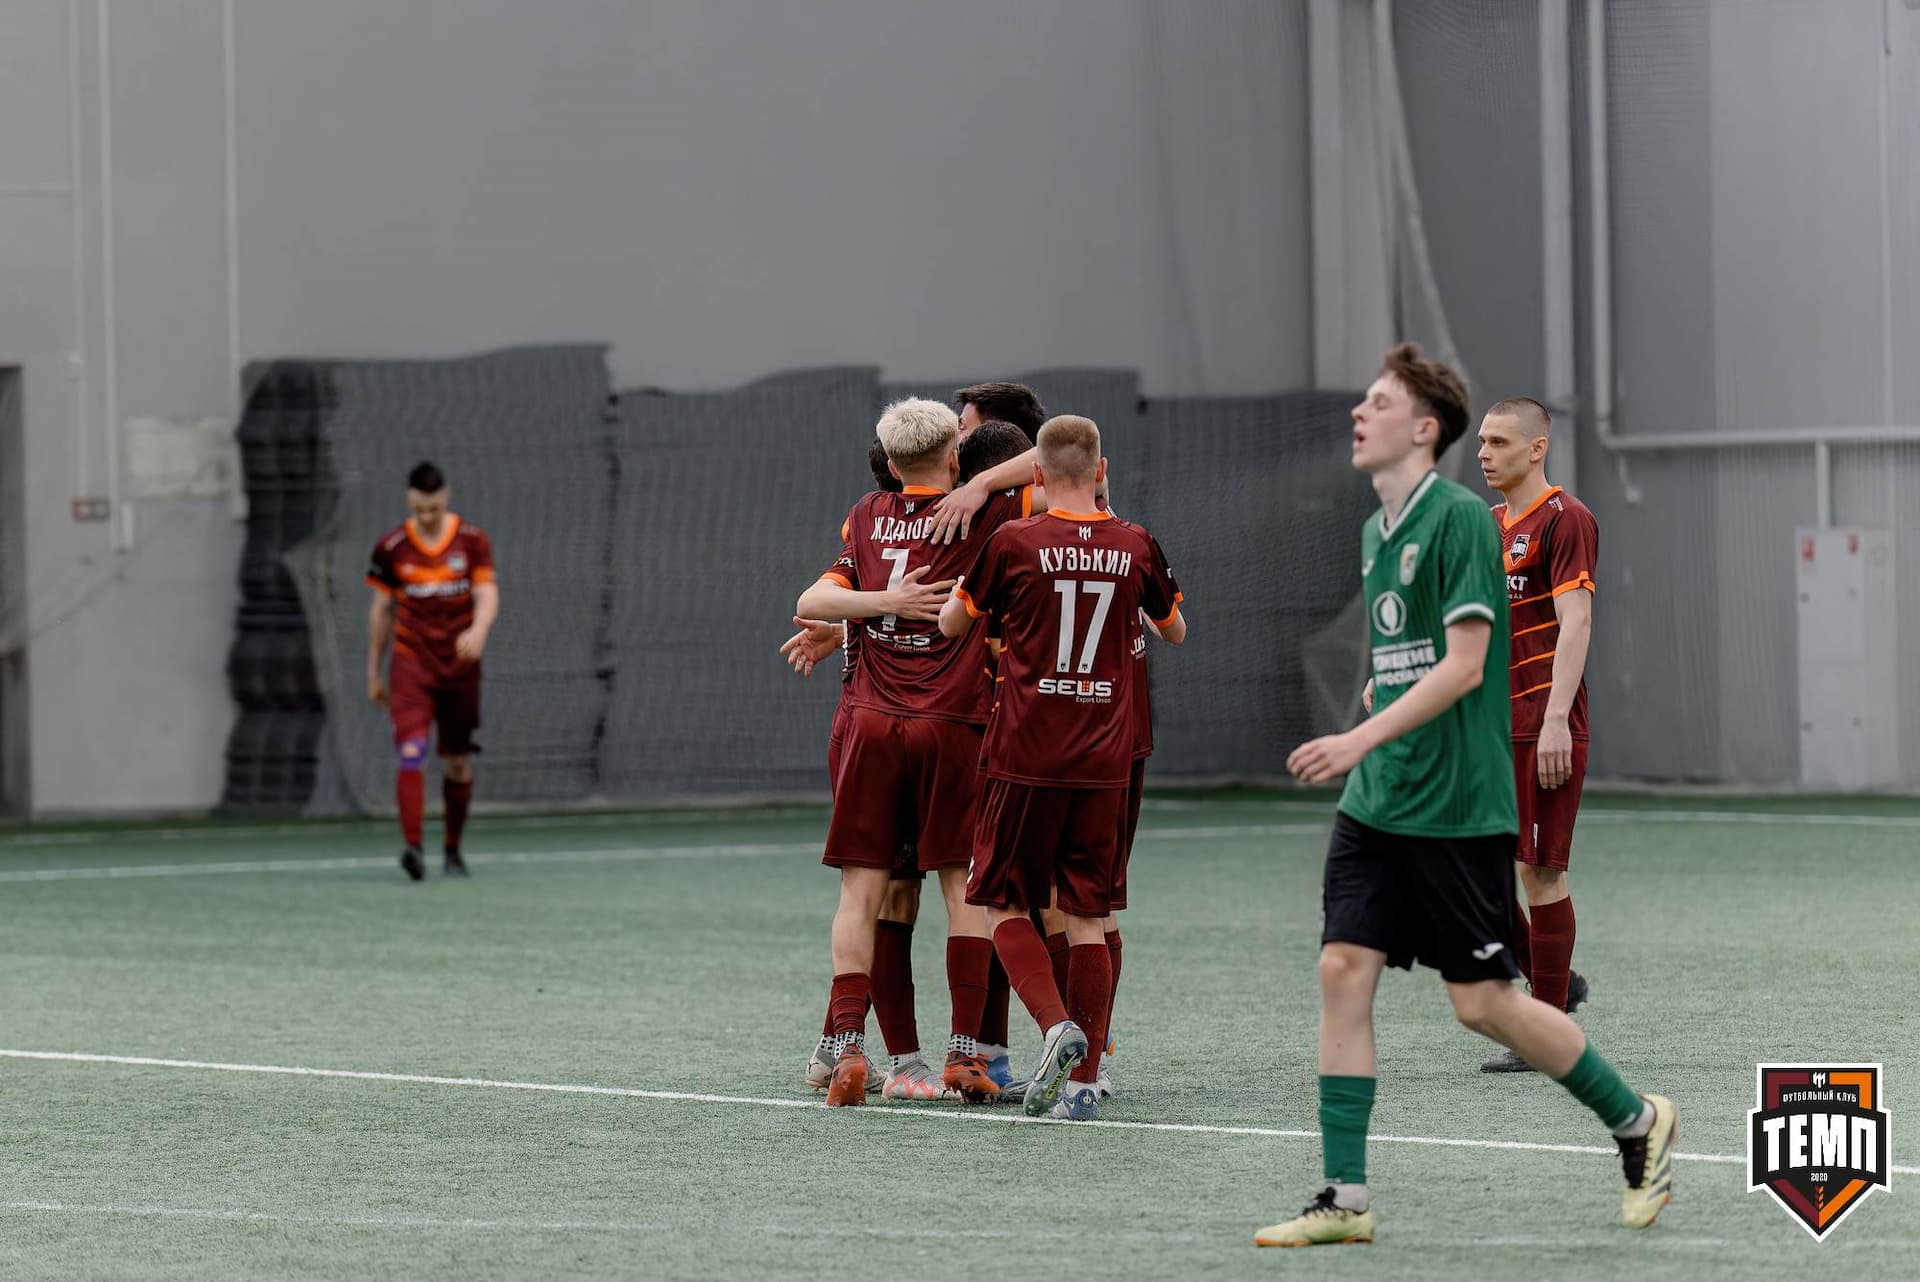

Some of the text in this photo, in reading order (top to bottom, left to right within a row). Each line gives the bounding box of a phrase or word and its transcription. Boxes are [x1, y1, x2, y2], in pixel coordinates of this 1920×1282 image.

[1039, 547, 1132, 577] КУЗЬКИН
[881, 548, 910, 631] 7
[1054, 579, 1116, 674] 17
[1037, 678, 1112, 697] SEUS
[1075, 696, 1095, 704] Export
